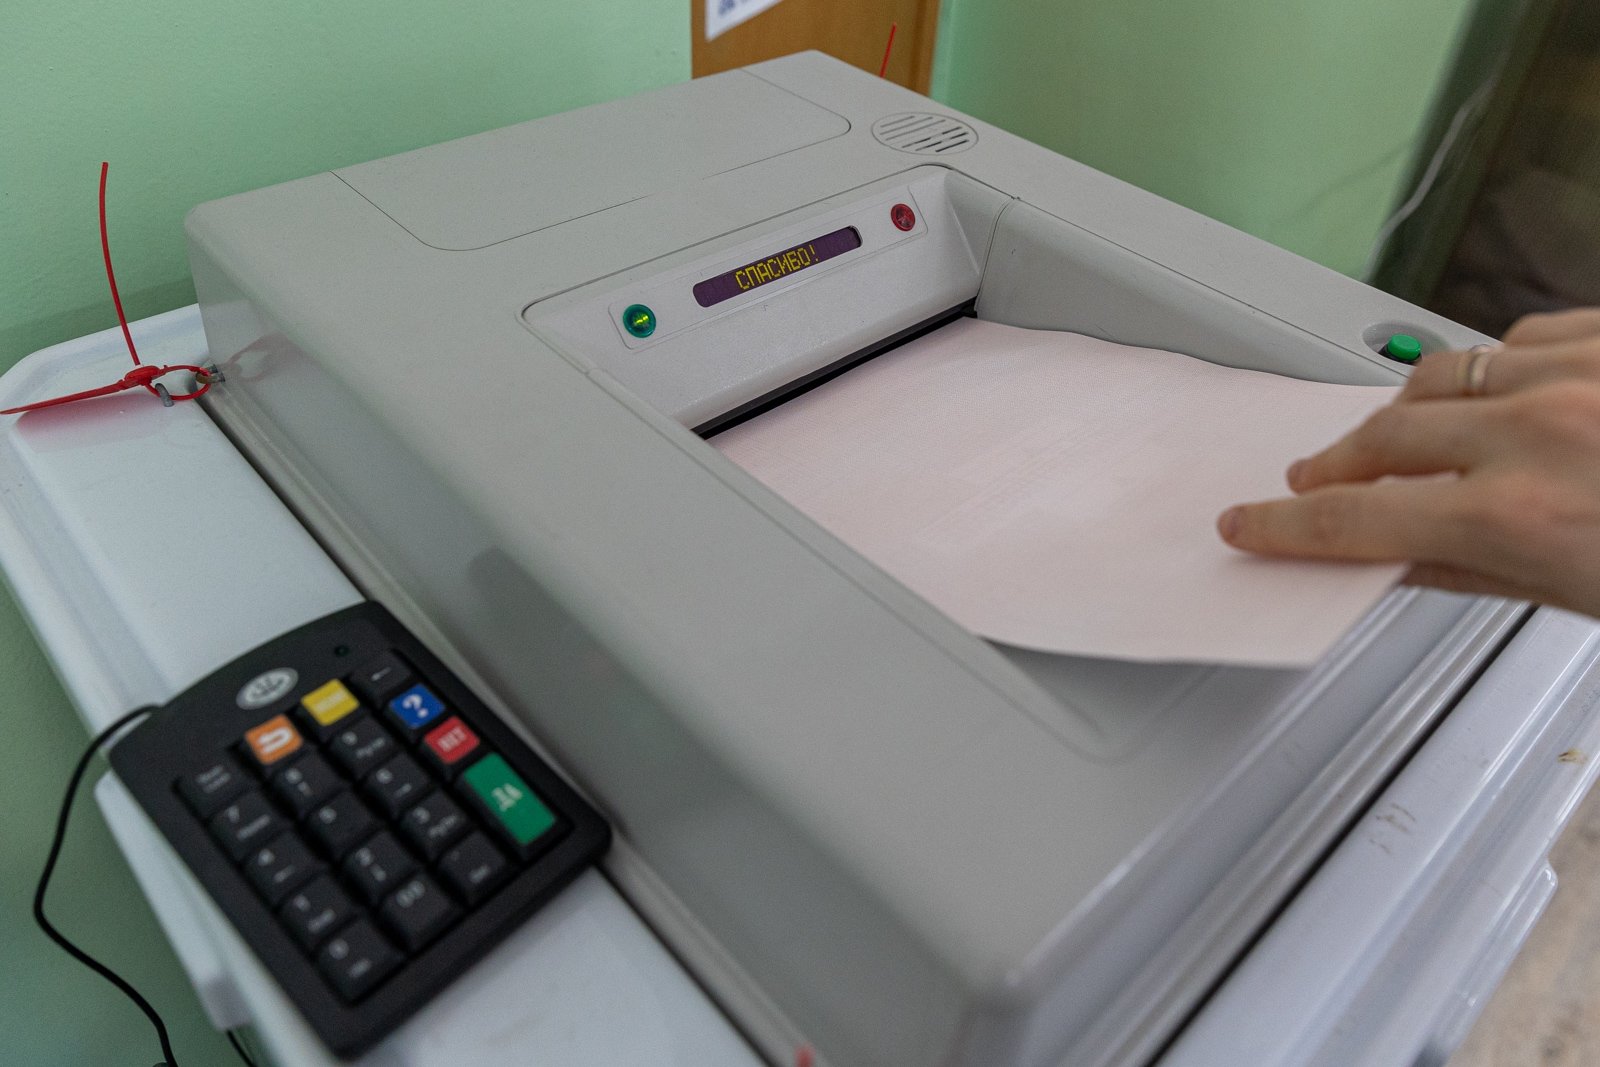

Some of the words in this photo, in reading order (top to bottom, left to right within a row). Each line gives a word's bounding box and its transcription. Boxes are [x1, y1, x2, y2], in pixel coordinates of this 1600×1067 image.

[735, 244, 820, 290] СПАСИБО!
[402, 693, 428, 718] ?
[490, 783, 523, 812] ДА
